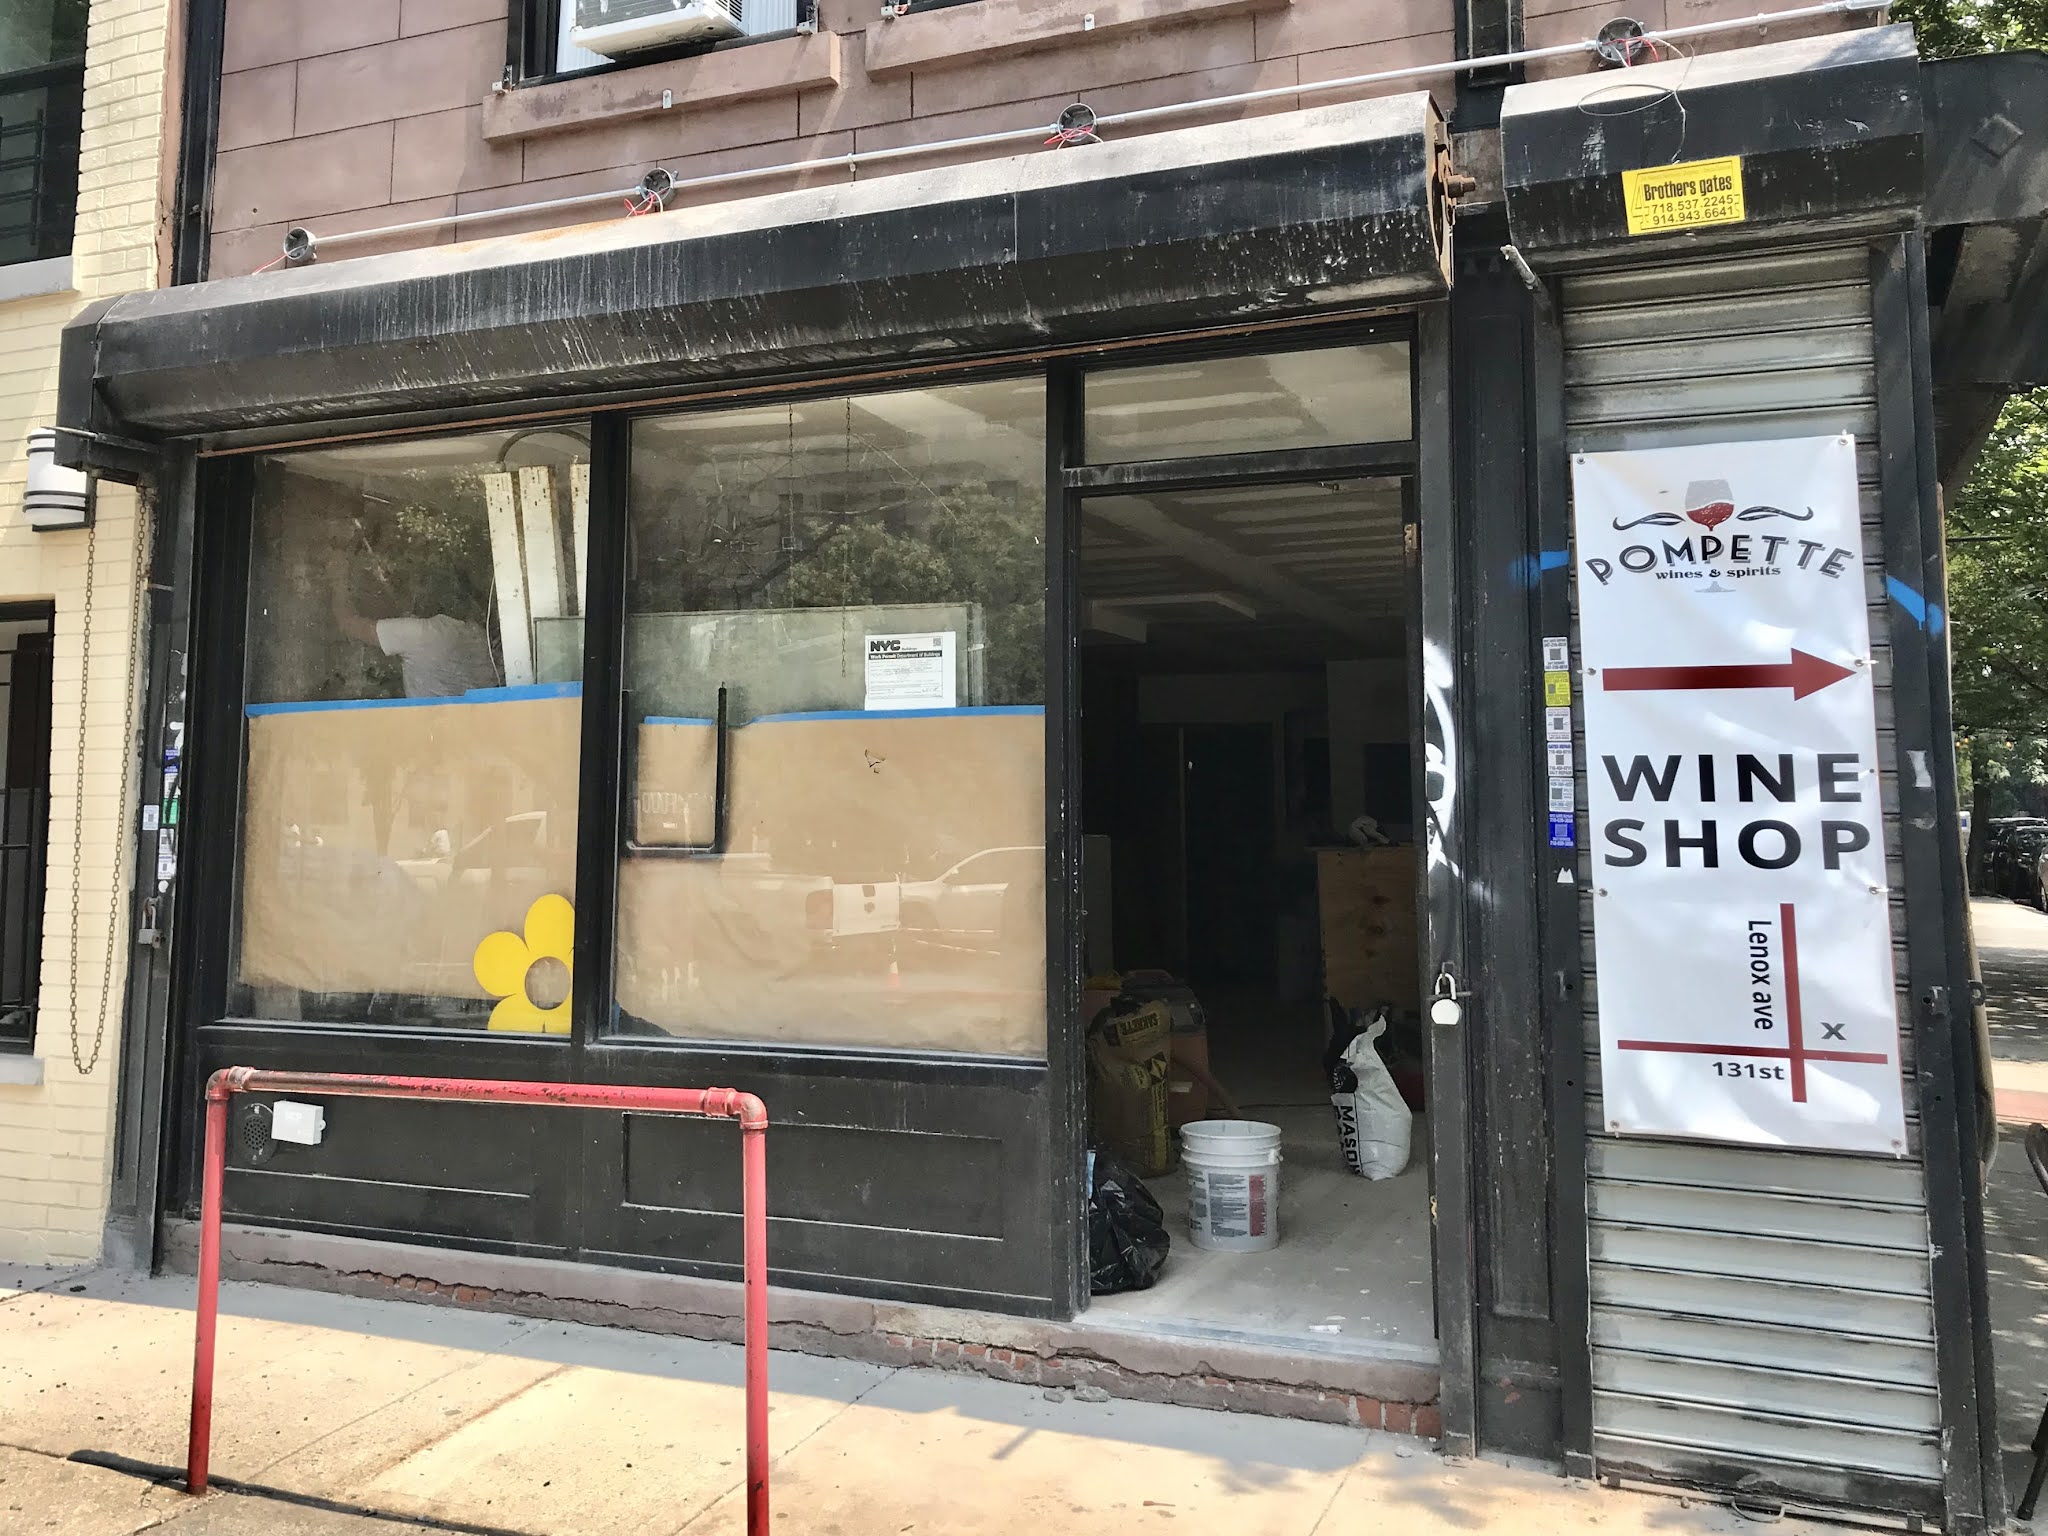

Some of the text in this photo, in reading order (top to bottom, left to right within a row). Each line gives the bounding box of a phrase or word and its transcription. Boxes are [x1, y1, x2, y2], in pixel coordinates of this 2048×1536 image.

[1643, 174, 1732, 202] Brothers gates
[1652, 194, 1734, 215] 718.537.2245
[1653, 205, 1734, 226] 914.943.6641
[1585, 534, 1855, 585] POMPETTE
[1655, 565, 1782, 580] wines & spirits
[870, 639, 901, 652] NYC
[1601, 753, 1862, 803] WINE
[1603, 818, 1871, 871] SHOP
[1747, 920, 1774, 1031] Lenox ave
[1711, 1060, 1785, 1081] 131st
